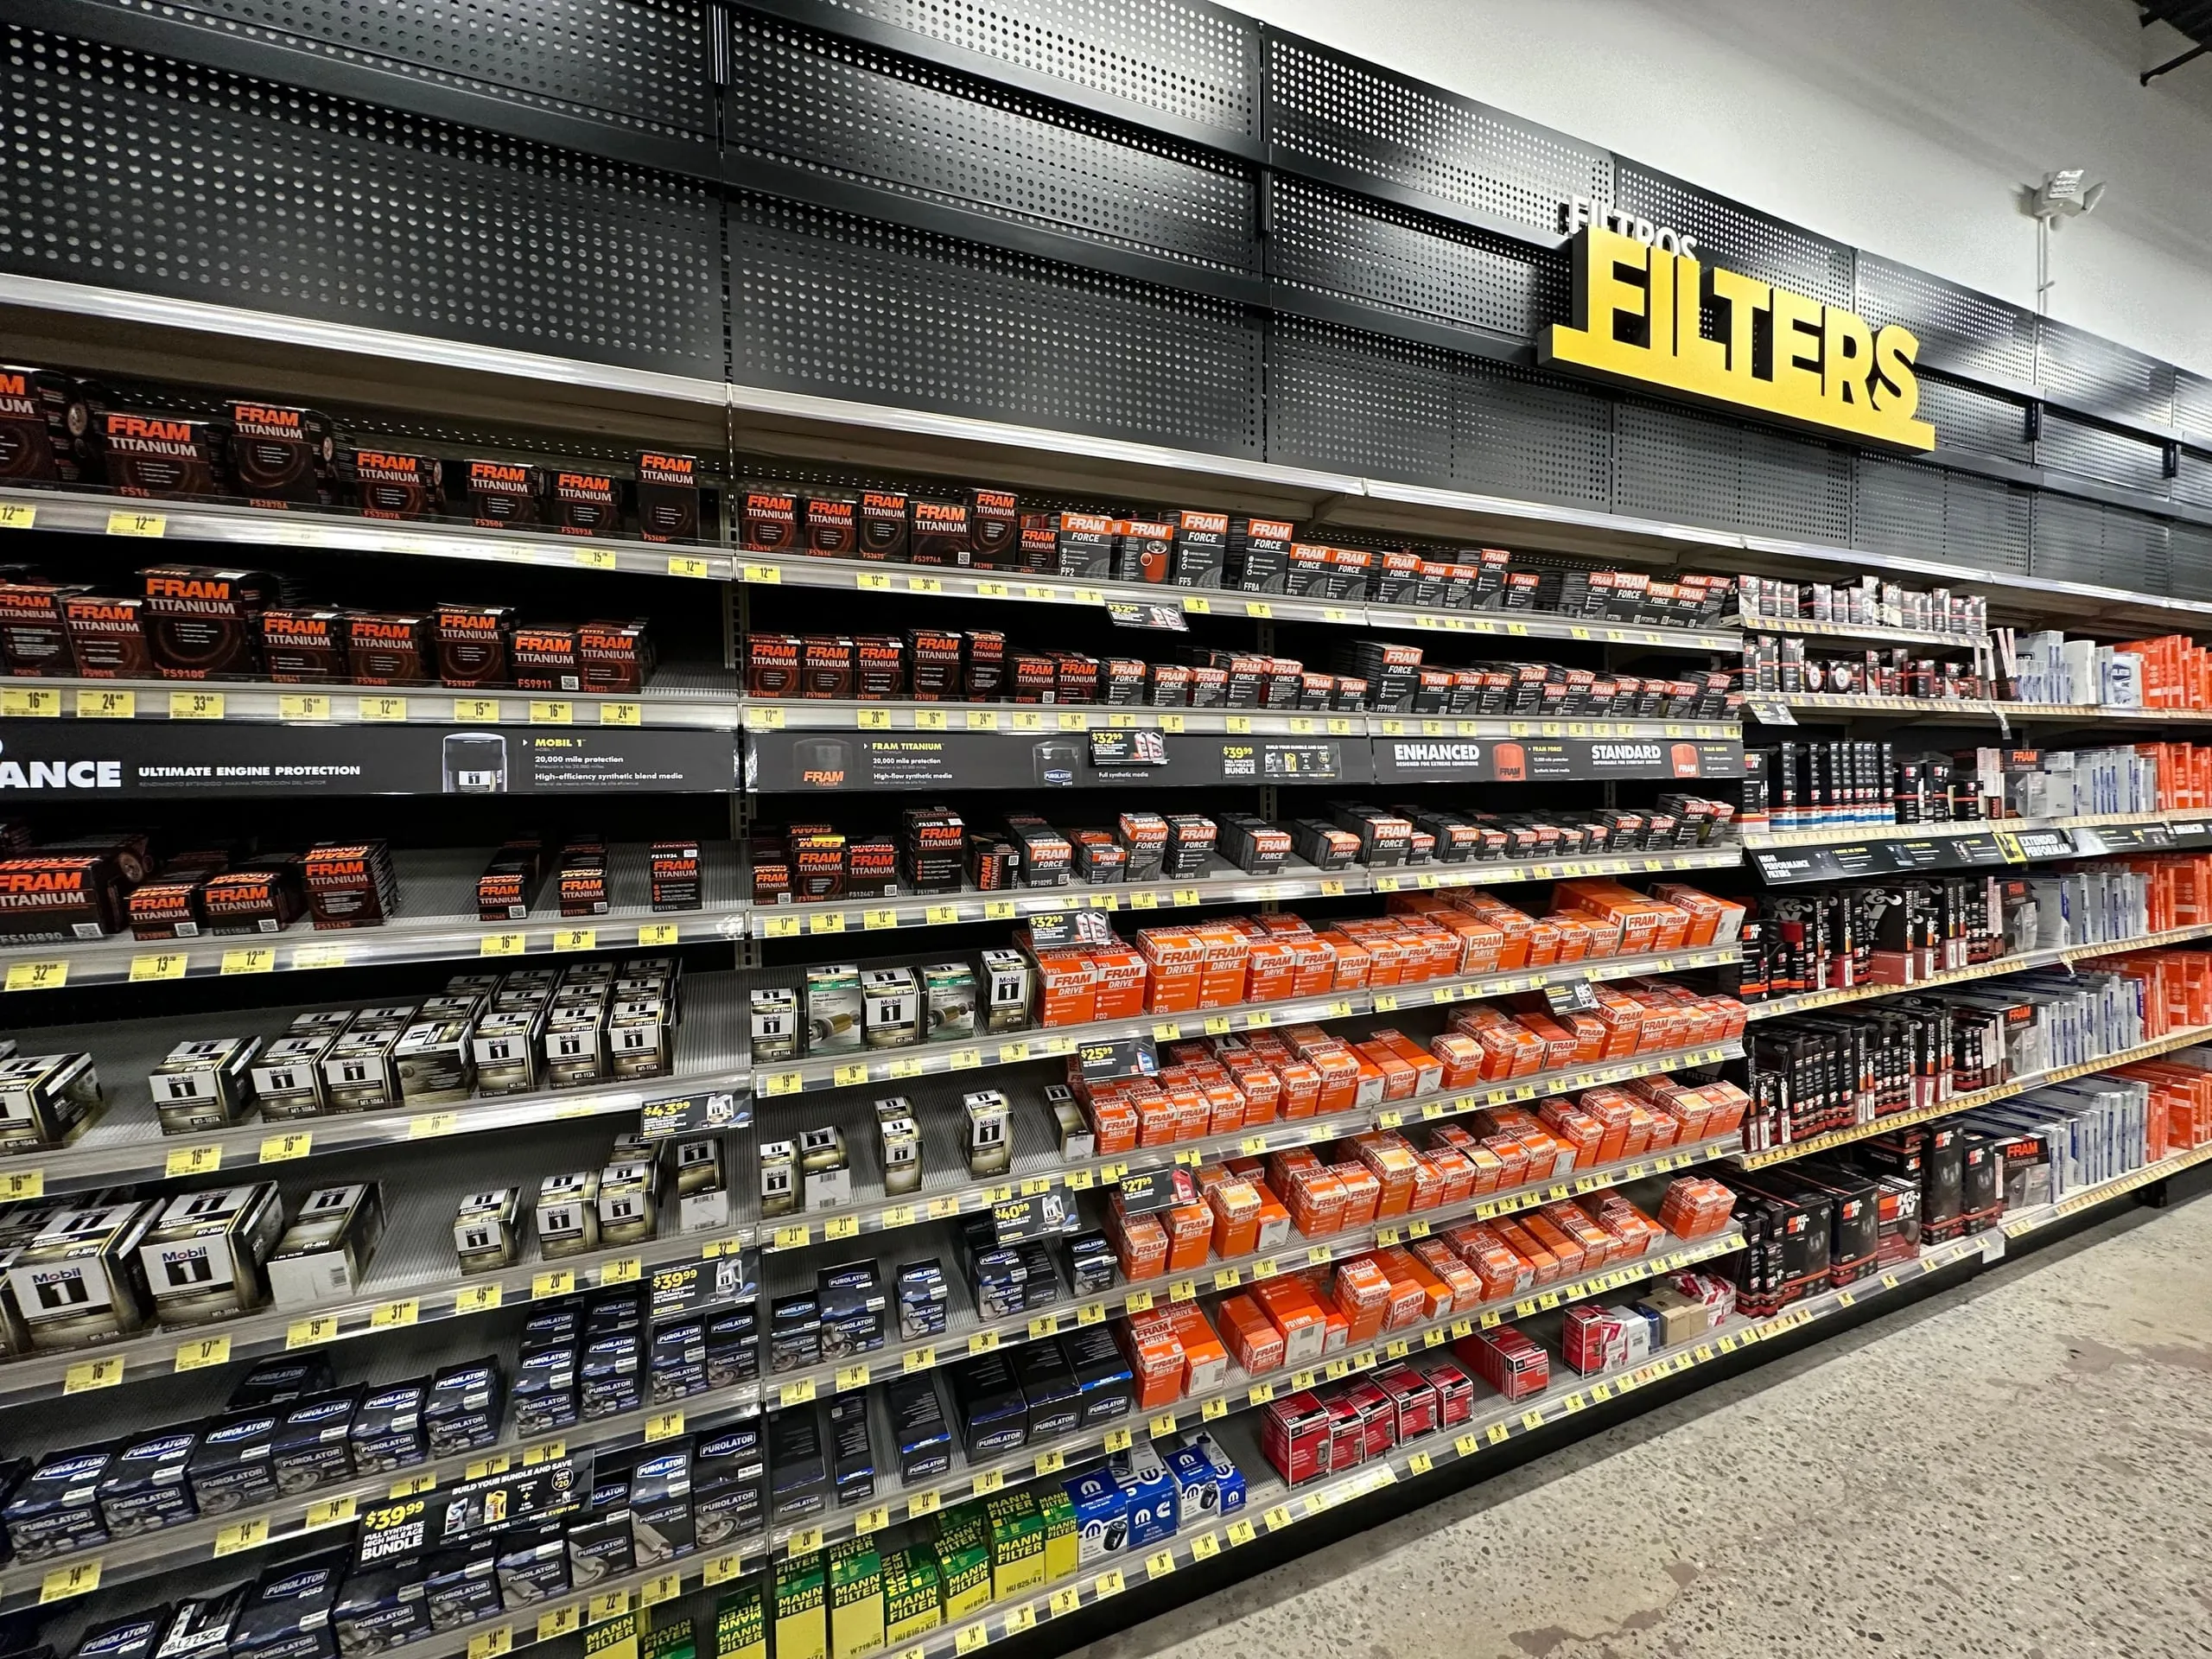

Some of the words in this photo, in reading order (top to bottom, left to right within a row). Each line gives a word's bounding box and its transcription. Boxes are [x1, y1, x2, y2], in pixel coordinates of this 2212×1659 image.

[1586, 225, 1920, 423] FILTERS
[235, 405, 298, 427] FRAM
[107, 416, 191, 442] FRAM
[236, 423, 303, 439] TITANIUM
[107, 436, 197, 457] TITANIUM
[358, 452, 416, 471] FRAM
[358, 468, 420, 483] TITANIUM
[558, 474, 609, 491] FRAM
[558, 488, 612, 501] TITANIUM
[747, 494, 792, 510] FRAM
[747, 508, 793, 520] TITANIUM
[916, 505, 965, 520] FRAM
[915, 520, 967, 533] TITANIUM
[1067, 519, 1106, 532] FRAM
[1185, 515, 1224, 531] FRAM
[1072, 532, 1099, 543] FORCE
[1188, 532, 1217, 543] FORCE
[1061, 567, 1074, 576] FF2
[1179, 577, 1191, 586] FF5
[1615, 575, 1649, 588] FRAM
[146, 578, 229, 600] FRAM
[1618, 589, 1640, 600] FORCE
[147, 599, 235, 614] TITANIUM
[515, 637, 572, 652] FRAM
[515, 652, 574, 664] TITANIUM
[1387, 651, 1420, 664] FRAM
[1389, 665, 1413, 675] FORCE
[518, 679, 552, 689] FS9911
[1395, 745, 1479, 760] ENHANCED
[1592, 746, 1661, 759] STANDARD
[2012, 752, 2037, 762] FRAM
[139, 767, 211, 777] ULTIMATE
[217, 766, 270, 776] ENGINE
[275, 766, 360, 775] PROTECTION
[535, 772, 596, 781] High-efficiency
[598, 772, 632, 781] synthetic
[804, 772, 843, 781] FRAM
[1500, 767, 1520, 776] FRAM
[2018, 835, 2056, 846] EXTENDED
[1033, 849, 1070, 860] FRAM
[653, 861, 696, 871] FRAM
[1629, 915, 1656, 928] FRAM
[1630, 928, 1649, 938] DRIVE
[1160, 950, 1203, 963] FRAM
[1166, 963, 1195, 974] DRIVE
[1053, 974, 1092, 986] FRAM
[1058, 987, 1084, 995] DRIVE
[2009, 1006, 2031, 1020] FRAM
[2006, 1142, 2038, 1157] FRAM
[2008, 1157, 2038, 1166] TITANIUM
[162, 1247, 207, 1262] Mobil
[33, 1267, 80, 1283] Mobil
[830, 1274, 869, 1287] PUROLATOR
[1255, 1344, 1281, 1358] FRAM
[37, 1457, 106, 1478] PUROLATOR
[639, 1457, 685, 1477] PUROLATOR
[71, 1470, 99, 1482] BOSS
[452, 1484, 477, 1495] BUILD
[478, 1479, 499, 1489] YOUR
[501, 1471, 532, 1484] BUNDLE
[534, 1465, 550, 1475] AND
[552, 1459, 572, 1471] SAVE
[667, 1469, 686, 1479] BOSS
[364, 1537, 385, 1548] HIGH
[386, 1528, 423, 1543] MILEAGE
[365, 1530, 386, 1541] FULL
[388, 1522, 424, 1537] SYNTHETIC
[361, 1536, 423, 1561] BUNDLE
[998, 1532, 1041, 1554] MANN
[998, 1542, 1042, 1565] FILTER
[836, 1573, 880, 1598] MANN
[1006, 1584, 1016, 1593] HU
[1018, 1578, 1036, 1589] 925/4
[836, 1585, 880, 1607] FILTER
